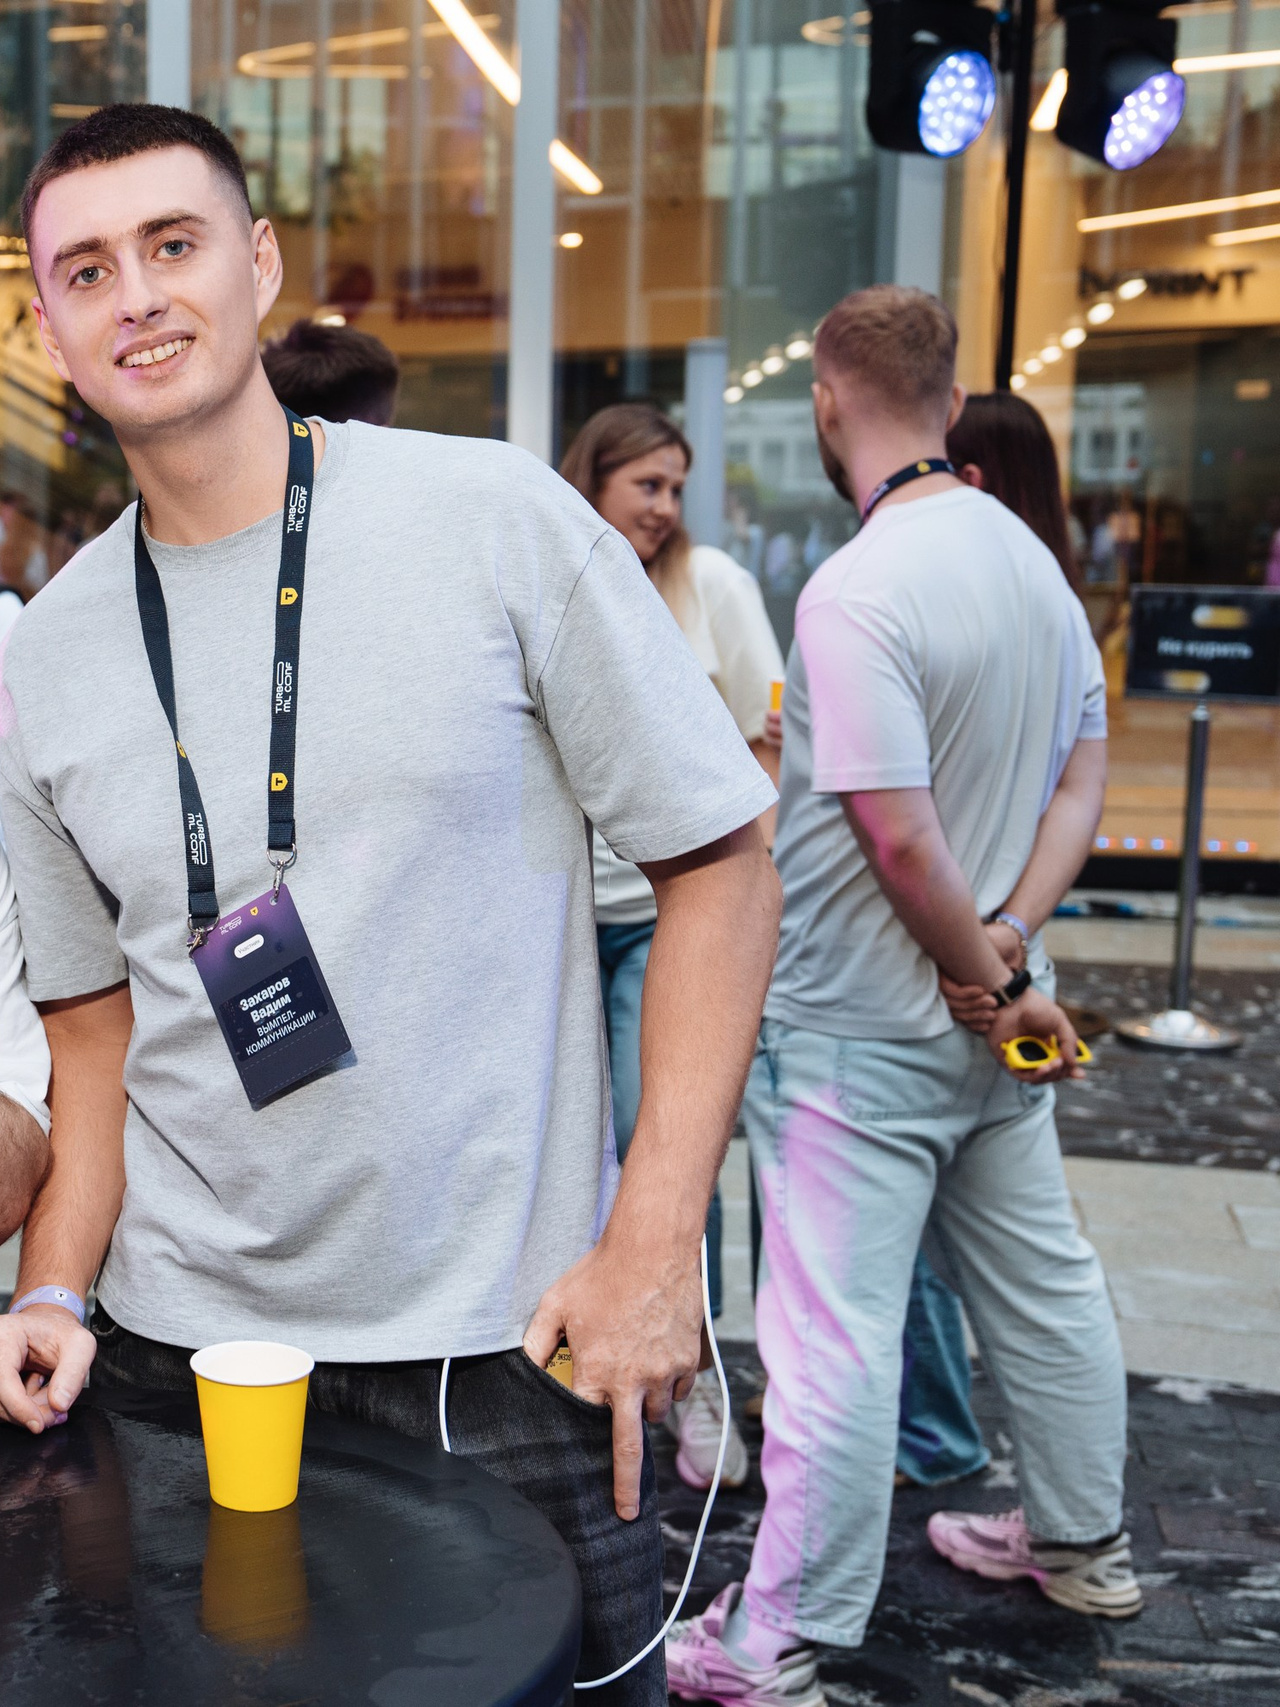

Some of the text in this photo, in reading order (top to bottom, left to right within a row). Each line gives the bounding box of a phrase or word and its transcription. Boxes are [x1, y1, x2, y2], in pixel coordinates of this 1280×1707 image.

[240, 977, 291, 1011] Захаров
[250, 994, 292, 1023] Вадим
[246, 1010, 317, 1055] КОММУНИКАЦИИ
[256, 1009, 296, 1037] ВЫМПЕЛ-
